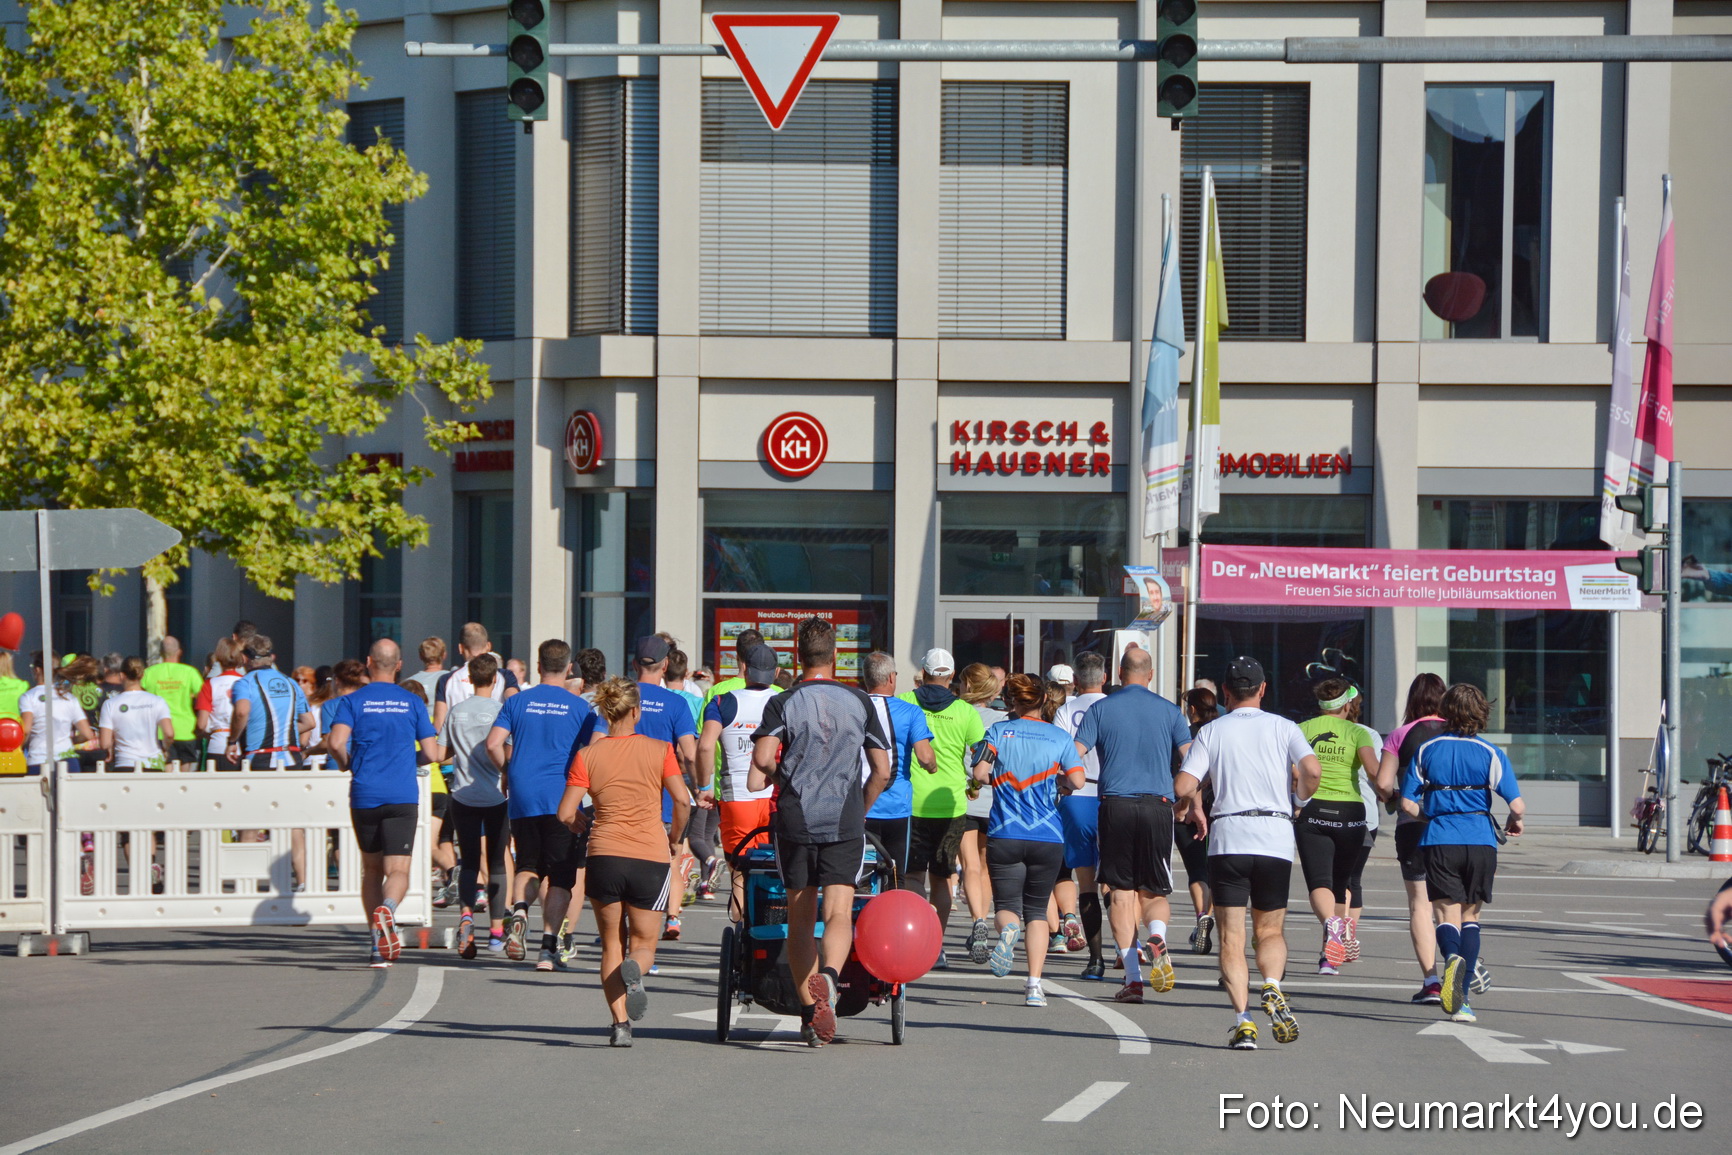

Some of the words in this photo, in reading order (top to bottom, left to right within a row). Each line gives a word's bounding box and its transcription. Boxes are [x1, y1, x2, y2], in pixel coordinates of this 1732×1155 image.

[953, 420, 1078, 443] KIRSCH
[1091, 421, 1110, 443] &
[573, 439, 588, 457] KH
[780, 439, 811, 459] KH
[953, 451, 1111, 473] HAUBNER
[1211, 560, 1246, 577] Der
[1383, 564, 1439, 581] feiert
[1443, 565, 1557, 585] Geburtstag
[1285, 584, 1331, 597] Freuen
[1333, 585, 1353, 597] Sie
[1355, 585, 1380, 598] sich
[1383, 586, 1405, 598] auf
[1407, 587, 1436, 599] tolle
[1438, 587, 1557, 602] Jubiläumsaktionen
[1579, 587, 1632, 595] NeuerMarkt
[757, 611, 815, 620] Neubau-Projekte
[1317, 754, 1345, 763] SPORTS
[1318, 744, 1346, 755] Wolff
[1307, 817, 1343, 828] SUNDRIED
